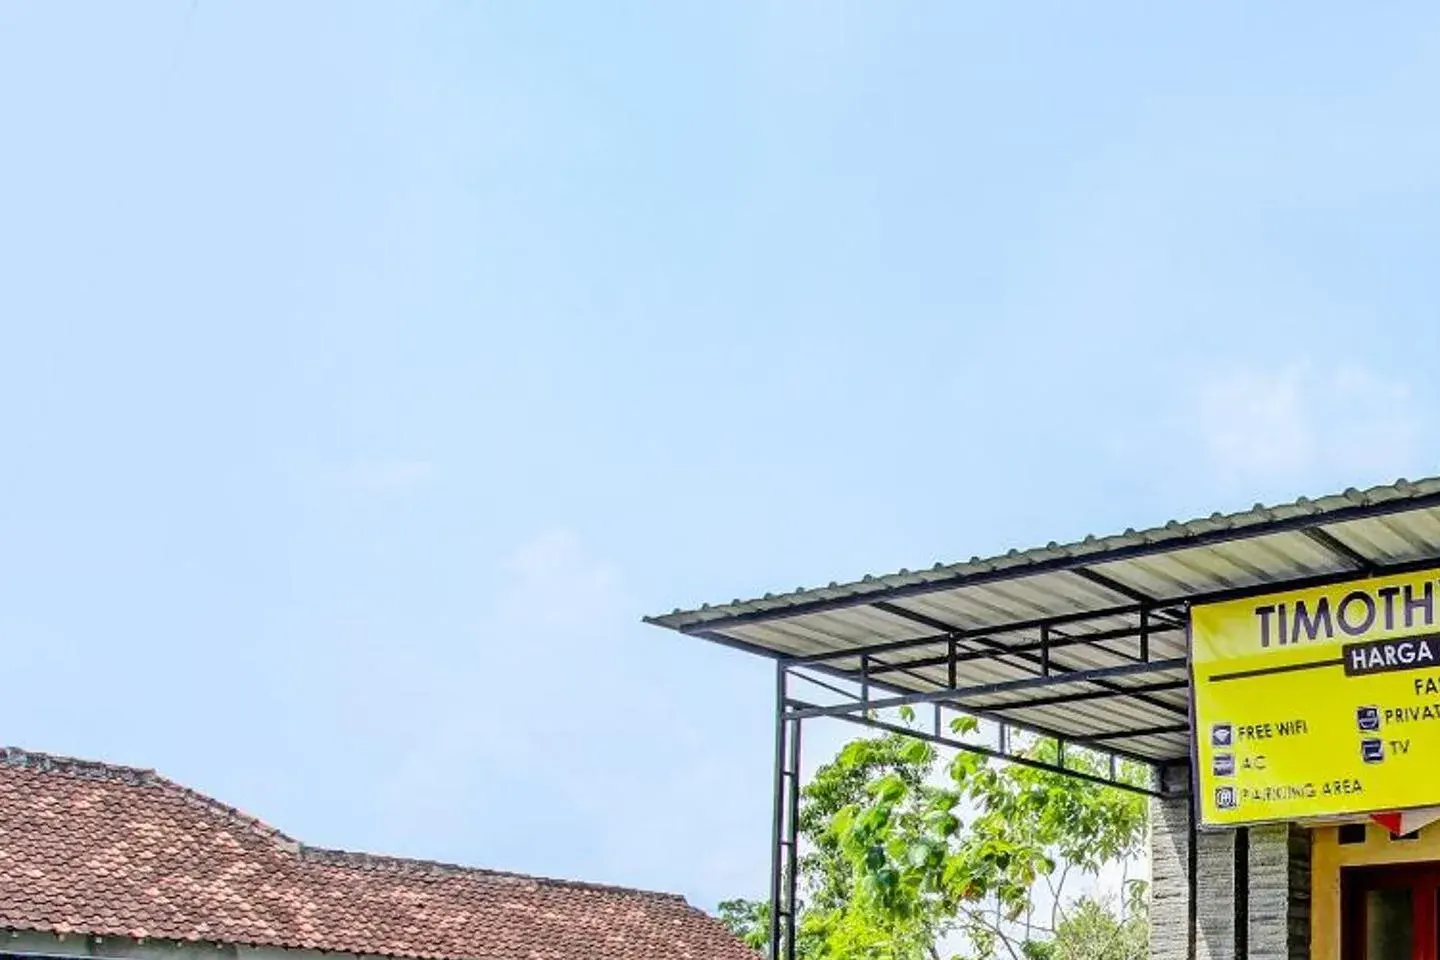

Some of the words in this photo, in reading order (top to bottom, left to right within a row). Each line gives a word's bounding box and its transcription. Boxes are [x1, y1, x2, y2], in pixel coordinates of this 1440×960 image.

[1351, 642, 1433, 670] HARGA
[1238, 723, 1275, 741] FREE
[1275, 720, 1309, 737] WIFI
[1390, 739, 1410, 754] TV
[1323, 779, 1363, 795] AREA
